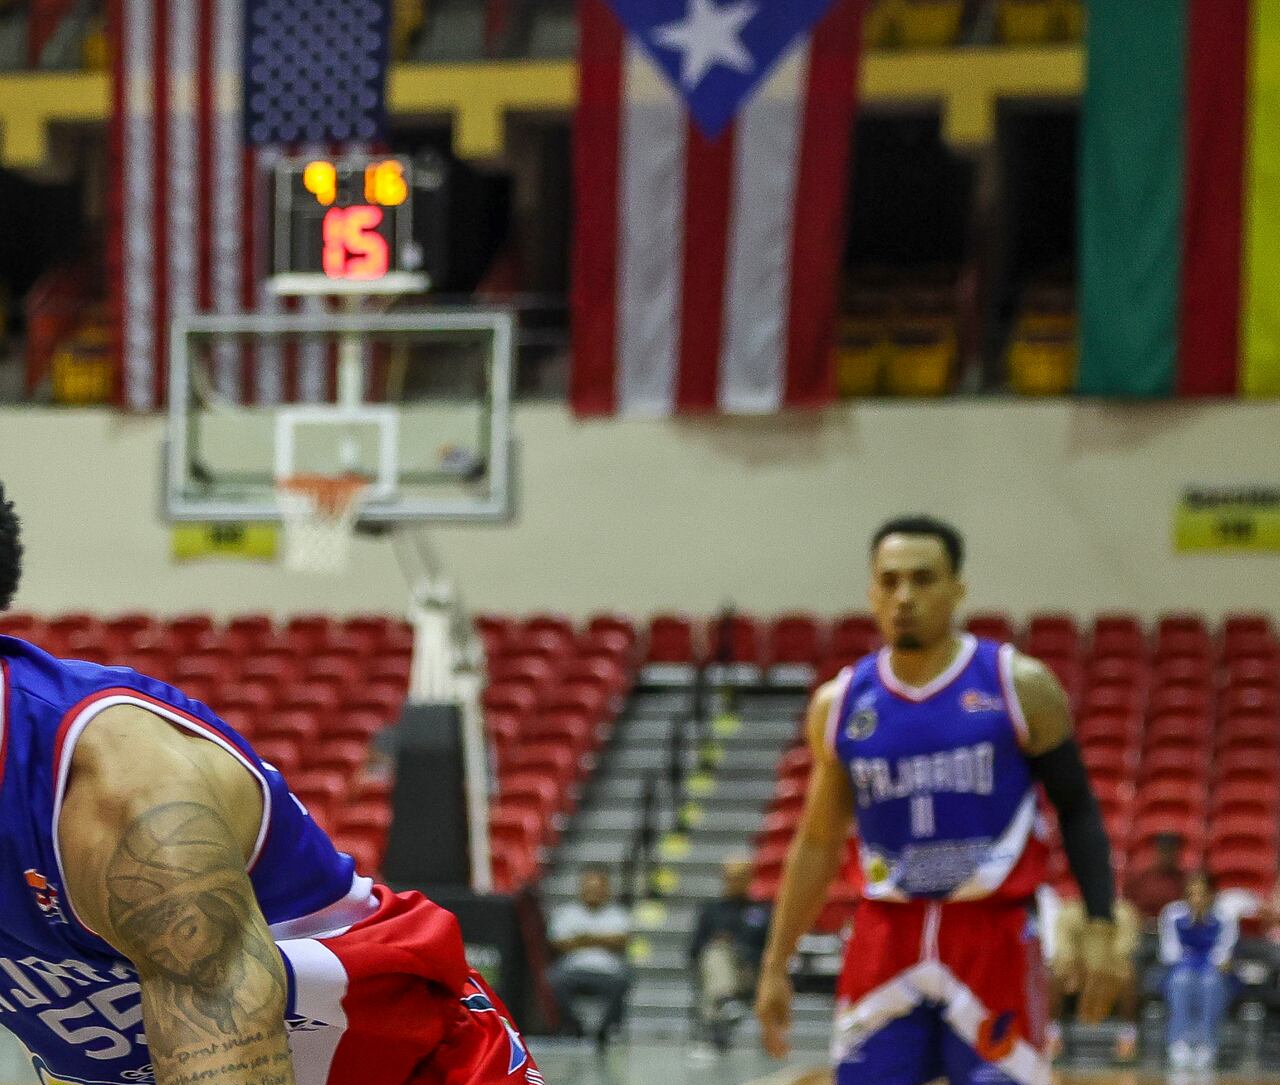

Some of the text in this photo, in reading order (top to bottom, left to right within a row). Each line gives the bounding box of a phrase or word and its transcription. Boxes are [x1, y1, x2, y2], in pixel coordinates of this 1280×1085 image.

[304, 159, 408, 206] 9 16
[323, 205, 389, 281] 15
[38, 982, 148, 1060] 55
